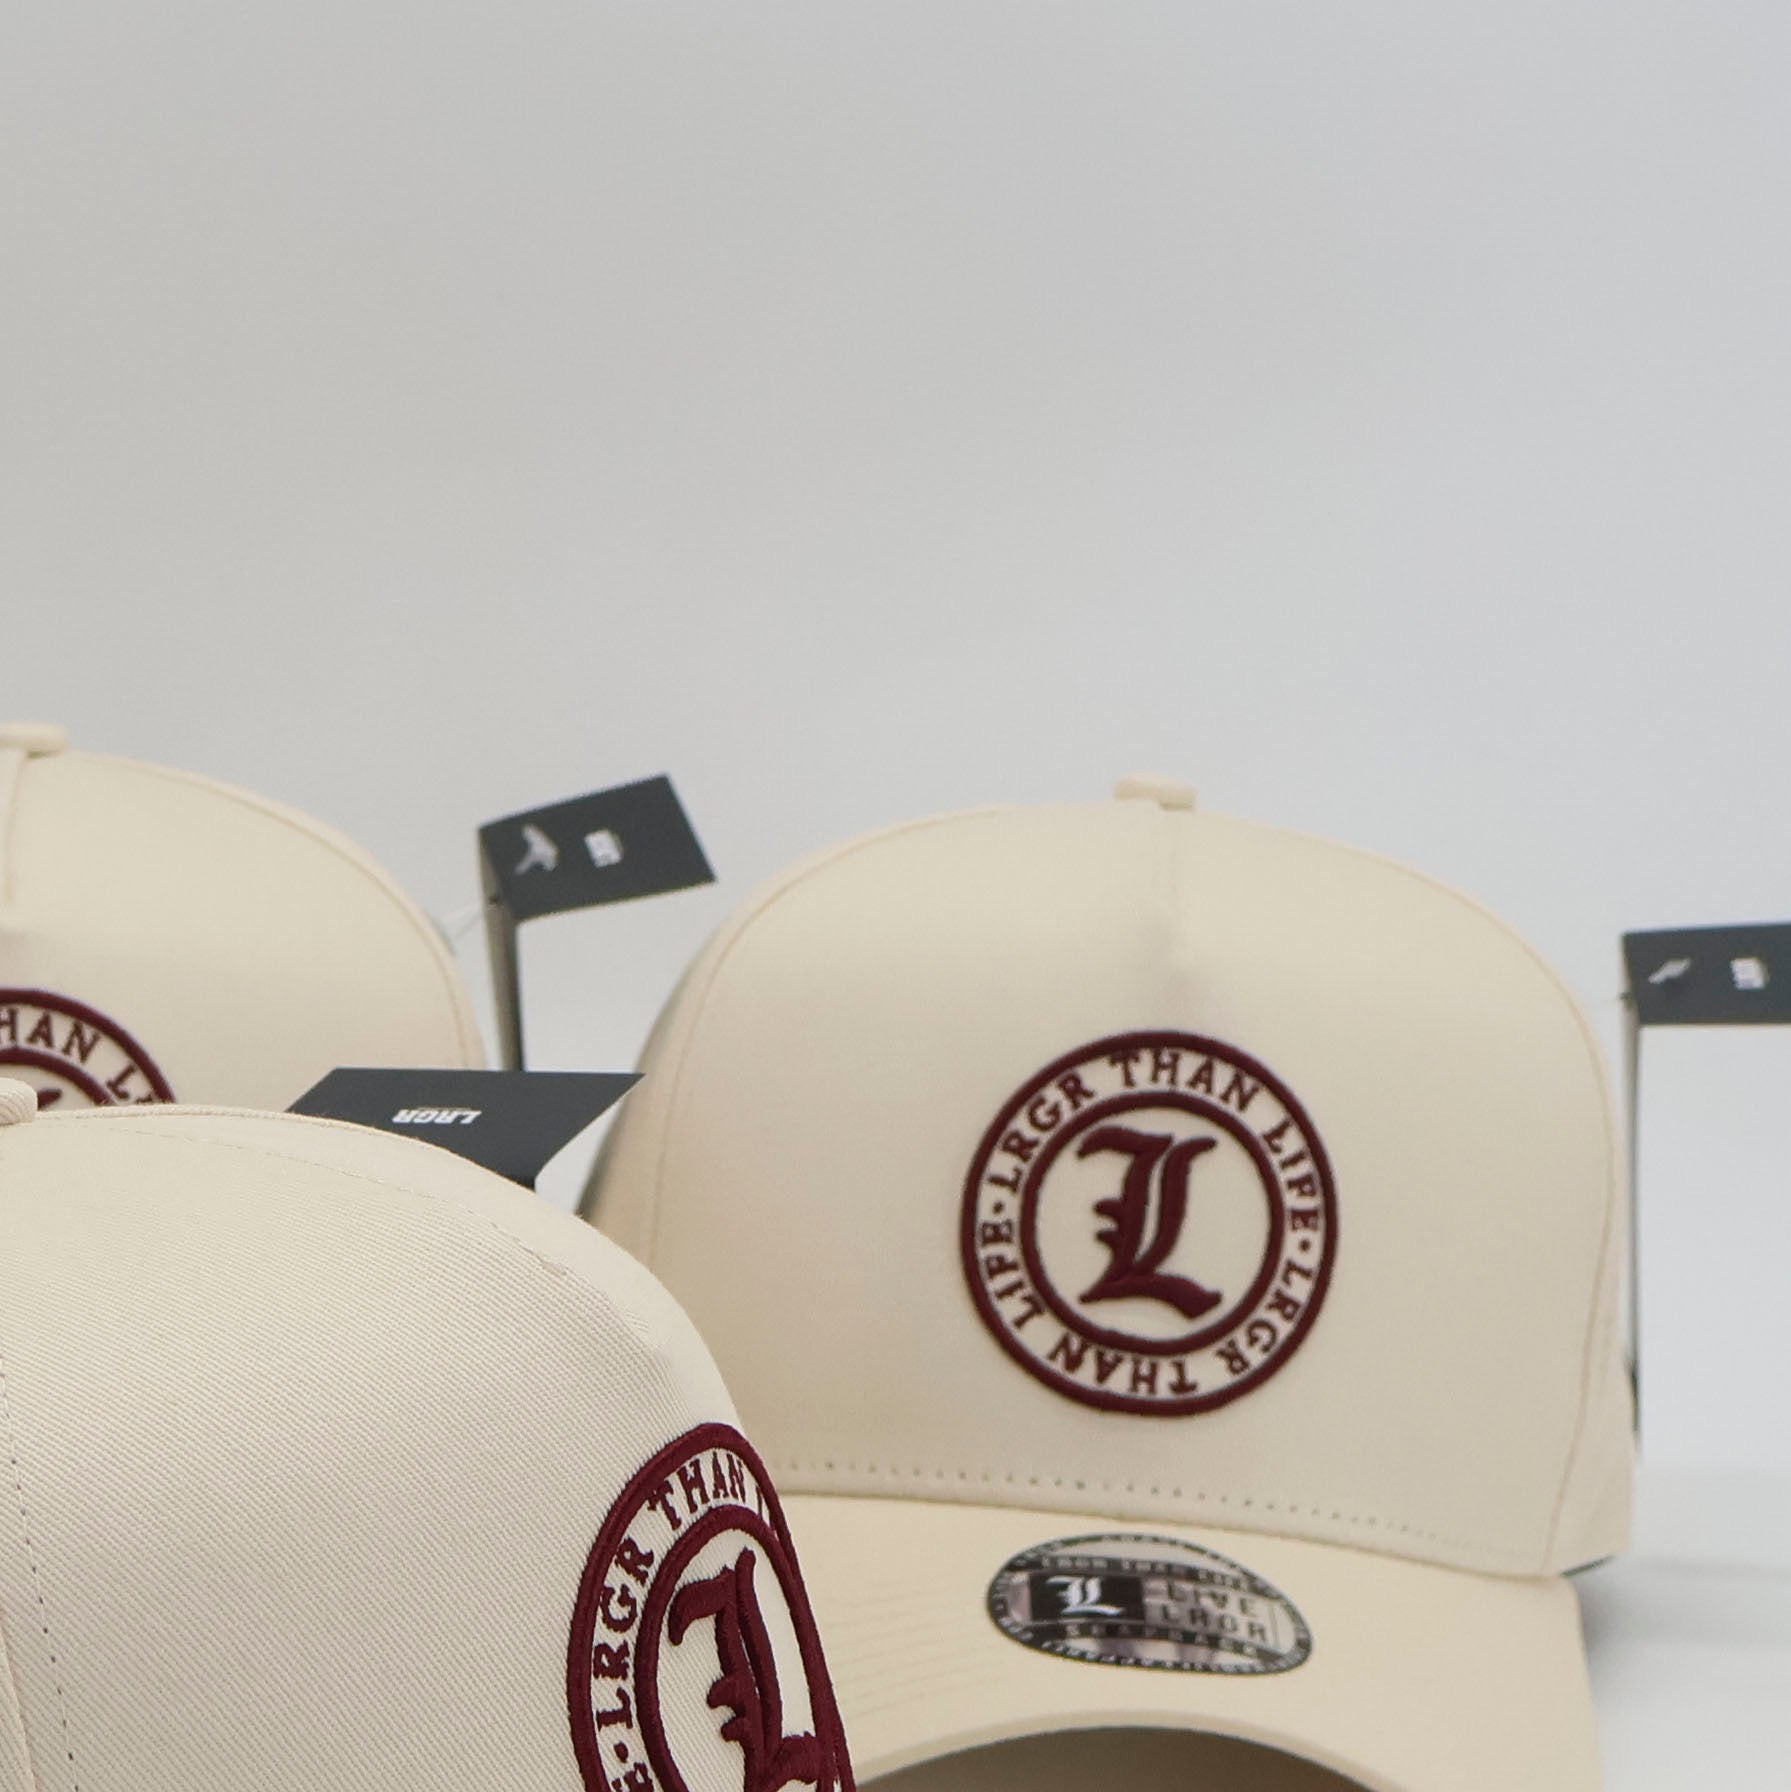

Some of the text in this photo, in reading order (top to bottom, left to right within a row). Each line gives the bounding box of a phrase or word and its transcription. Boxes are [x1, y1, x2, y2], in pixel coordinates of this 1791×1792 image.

[989, 1050, 1320, 1232] LRGR THAN LIFE
[981, 1221, 1313, 1395] LRGR THAN LIFE
[594, 1451, 746, 1733] LRGR THAN
